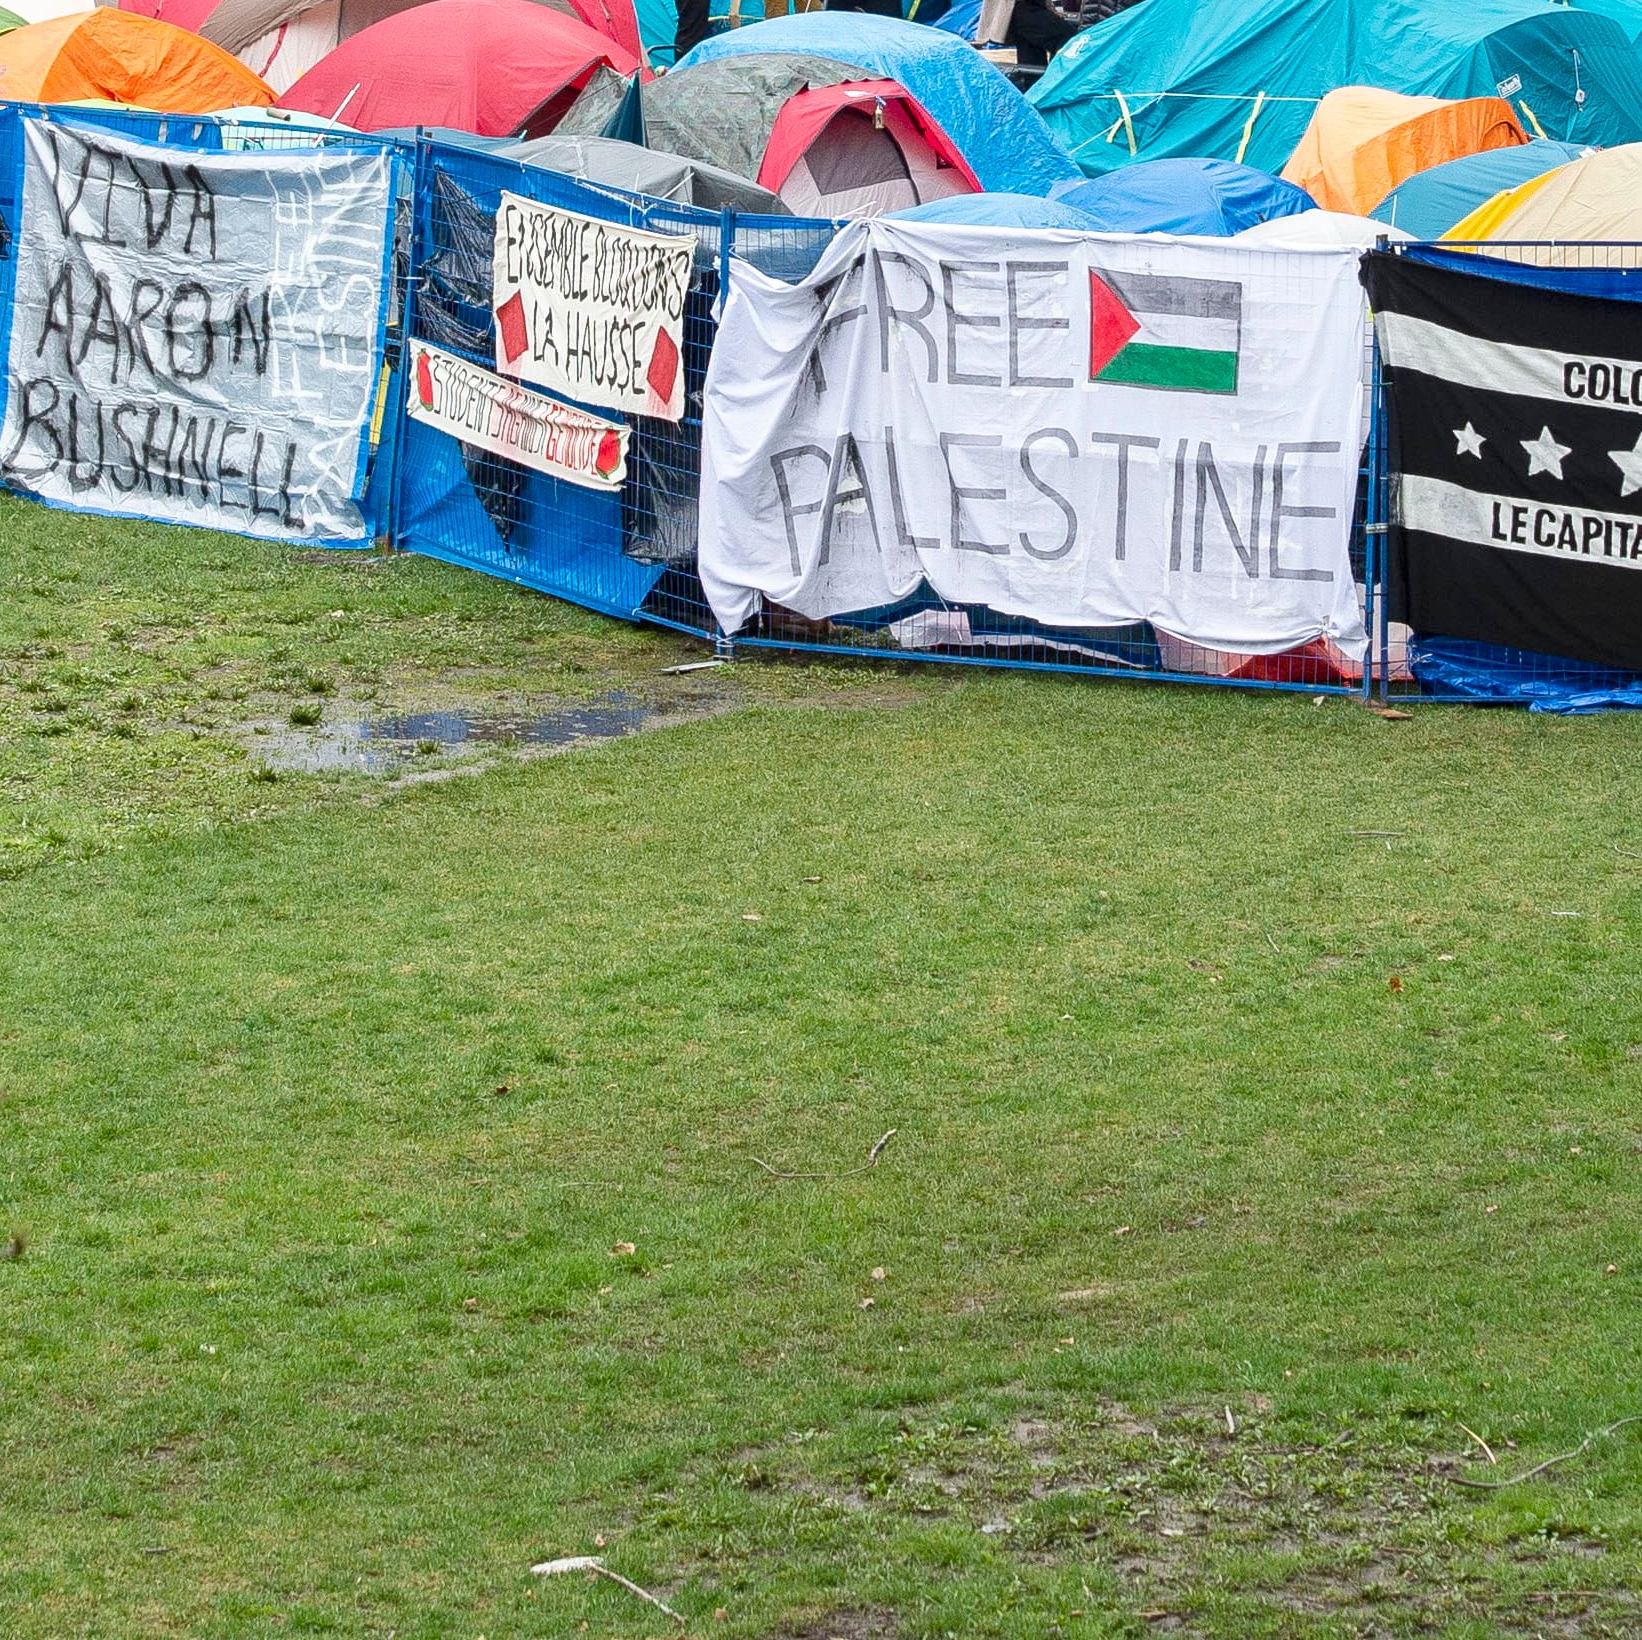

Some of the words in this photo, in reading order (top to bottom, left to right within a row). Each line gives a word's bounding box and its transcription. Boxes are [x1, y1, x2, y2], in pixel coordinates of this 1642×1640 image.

[46, 126, 217, 261] VIVA
[36, 261, 272, 384] AARON
[506, 204, 590, 302] ENSEMBLE
[593, 226, 690, 322] BLOQUONS
[805, 248, 1075, 398] FREE
[533, 300, 559, 366] LA
[0, 376, 306, 530] BUSHNELL
[770, 425, 1342, 583] PALESTINE
[1492, 501, 1528, 545] LE
